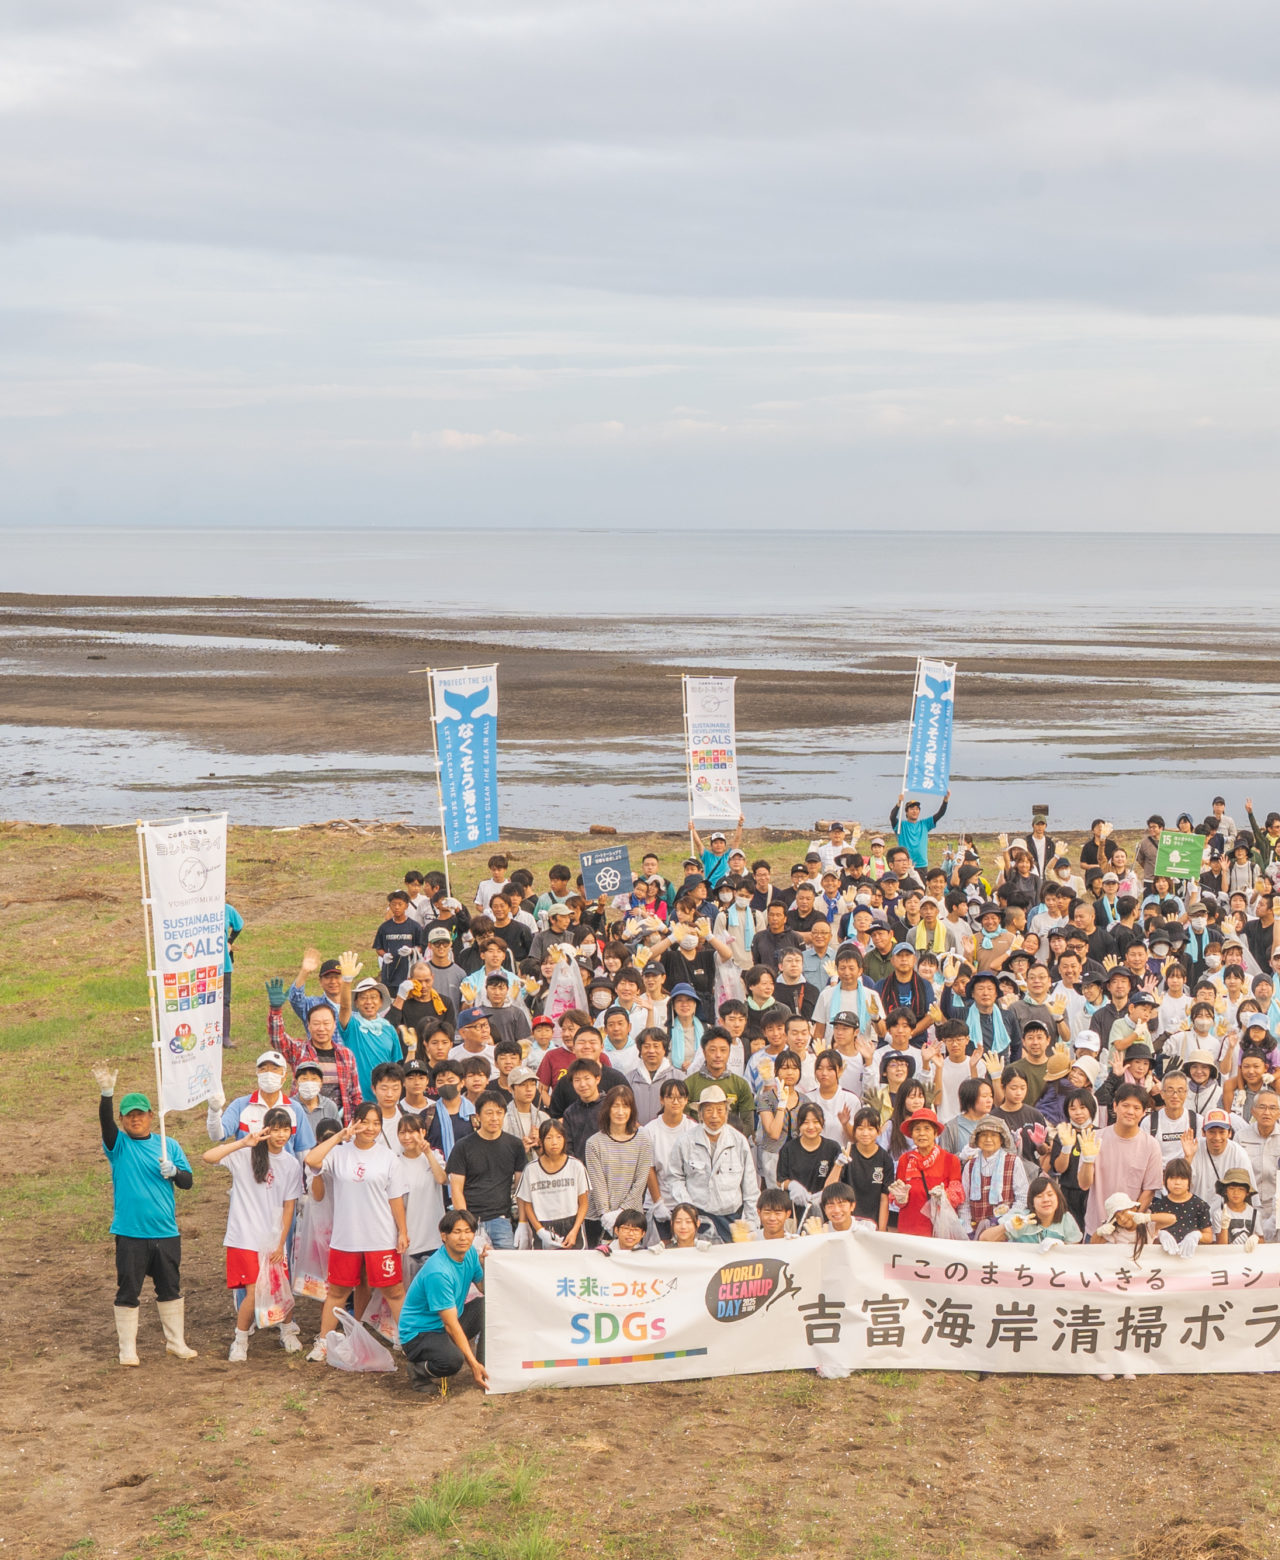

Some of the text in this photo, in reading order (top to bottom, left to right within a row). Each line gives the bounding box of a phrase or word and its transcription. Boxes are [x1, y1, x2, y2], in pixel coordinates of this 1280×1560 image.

[692, 735, 731, 745] GOALS
[1162, 835, 1172, 845] 15
[582, 855, 592, 867] 17
[163, 910, 224, 929] SUSTAINABLE
[164, 923, 224, 940] DEVELOPMENT
[165, 935, 224, 962] GOALS
[721, 1263, 764, 1284] WORLD
[891, 1254, 1166, 1291] 「このまちといきる
[556, 1276, 664, 1298] 未来につなぐ
[718, 1278, 773, 1300] CLEANUP
[717, 1299, 743, 1318] DAY
[570, 1311, 667, 1345] SDGs
